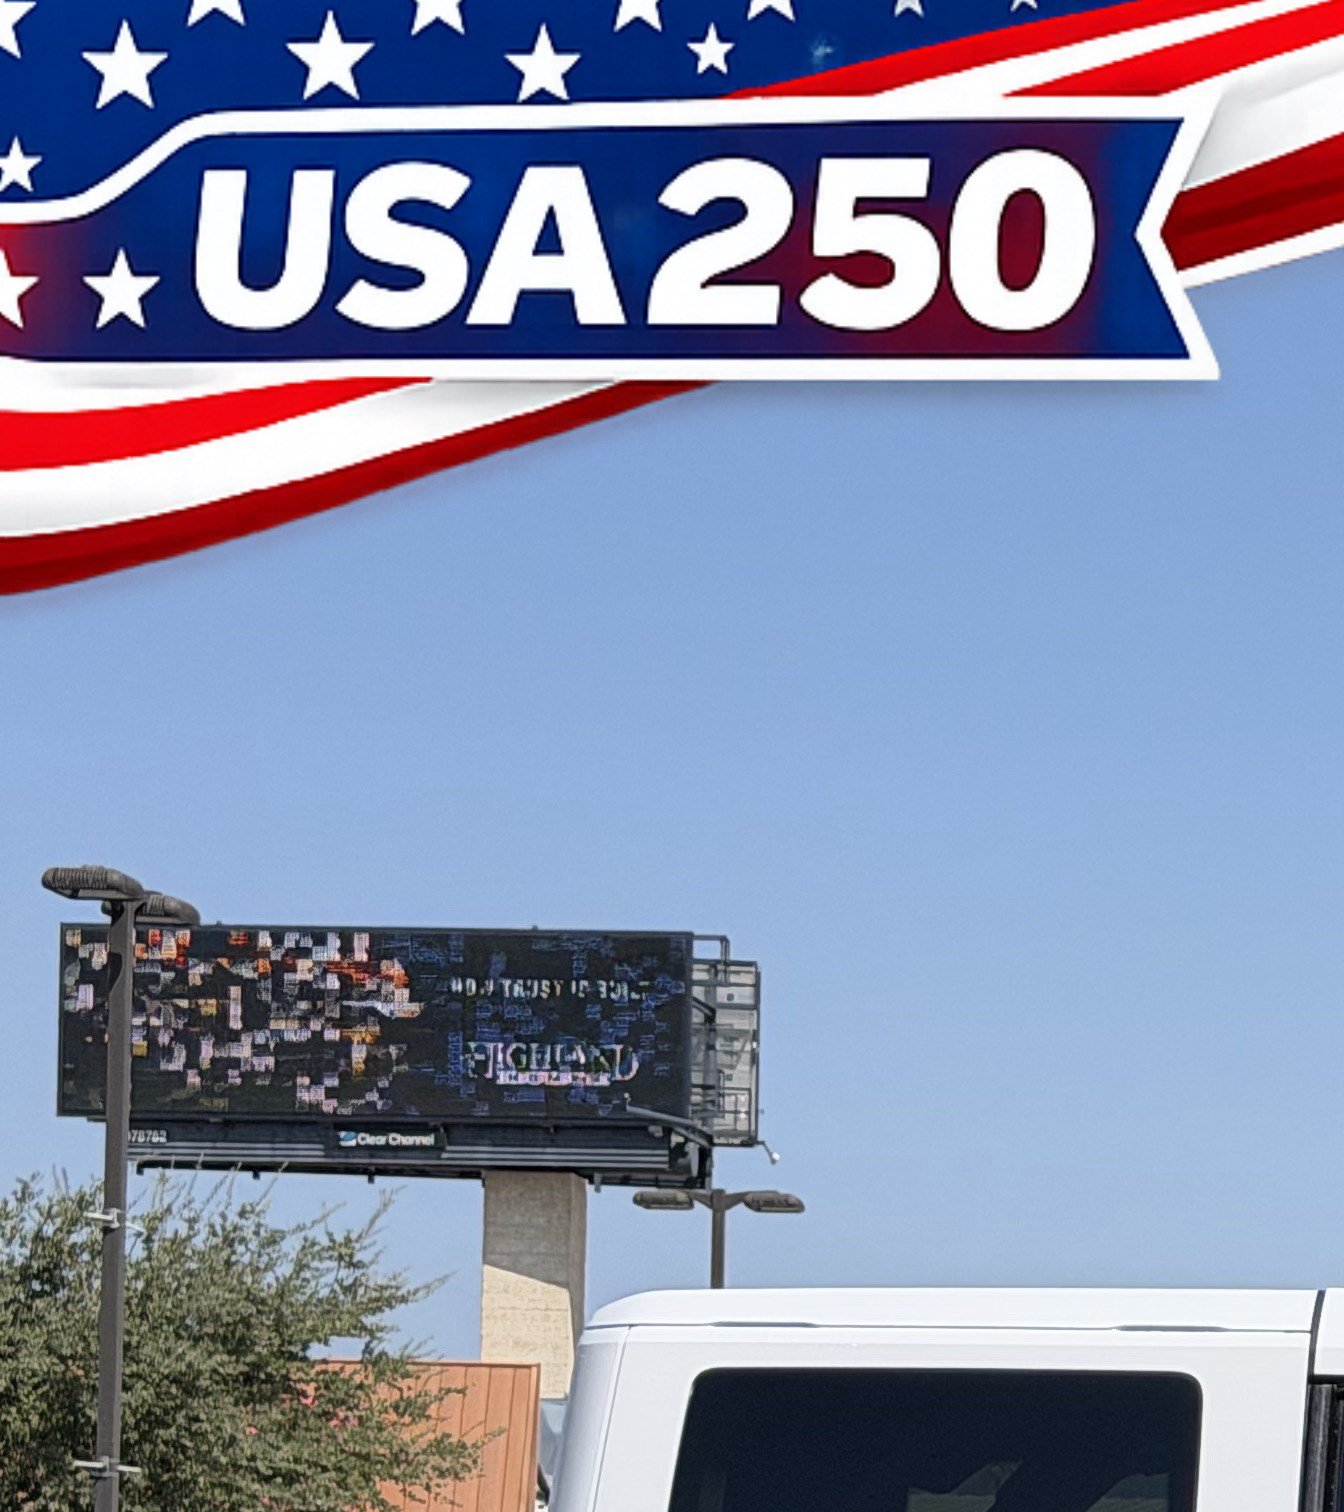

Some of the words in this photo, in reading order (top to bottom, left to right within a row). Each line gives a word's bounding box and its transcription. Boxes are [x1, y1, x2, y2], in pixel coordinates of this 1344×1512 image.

[461, 1041, 640, 1081] HIGHLAND
[357, 1132, 387, 1146] Clear
[388, 1132, 435, 1147] Channel
